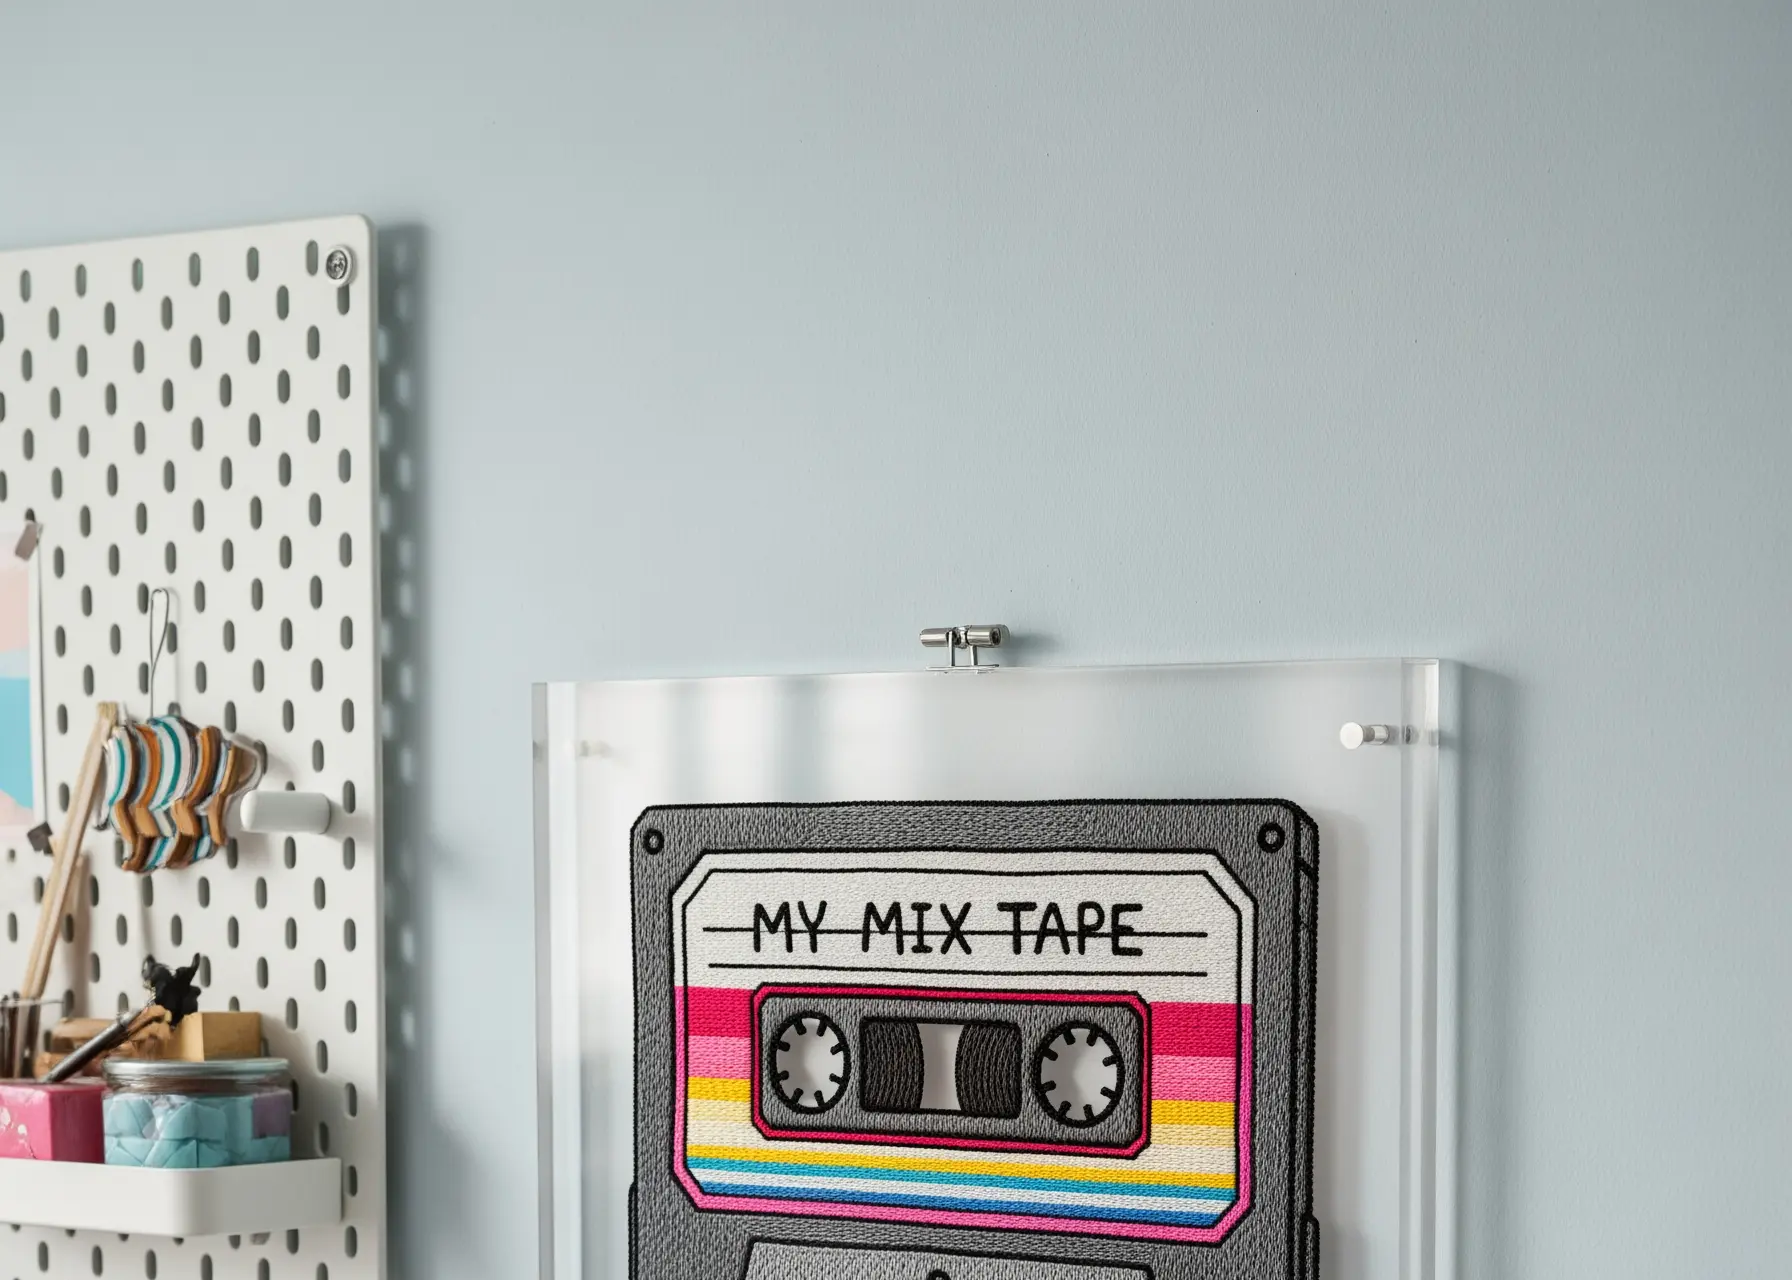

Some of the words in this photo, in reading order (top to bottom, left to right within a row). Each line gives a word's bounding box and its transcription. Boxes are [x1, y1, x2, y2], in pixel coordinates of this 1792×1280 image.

[753, 900, 827, 953] MY
[861, 901, 972, 955] MIX
[997, 901, 1143, 956] TAPE
